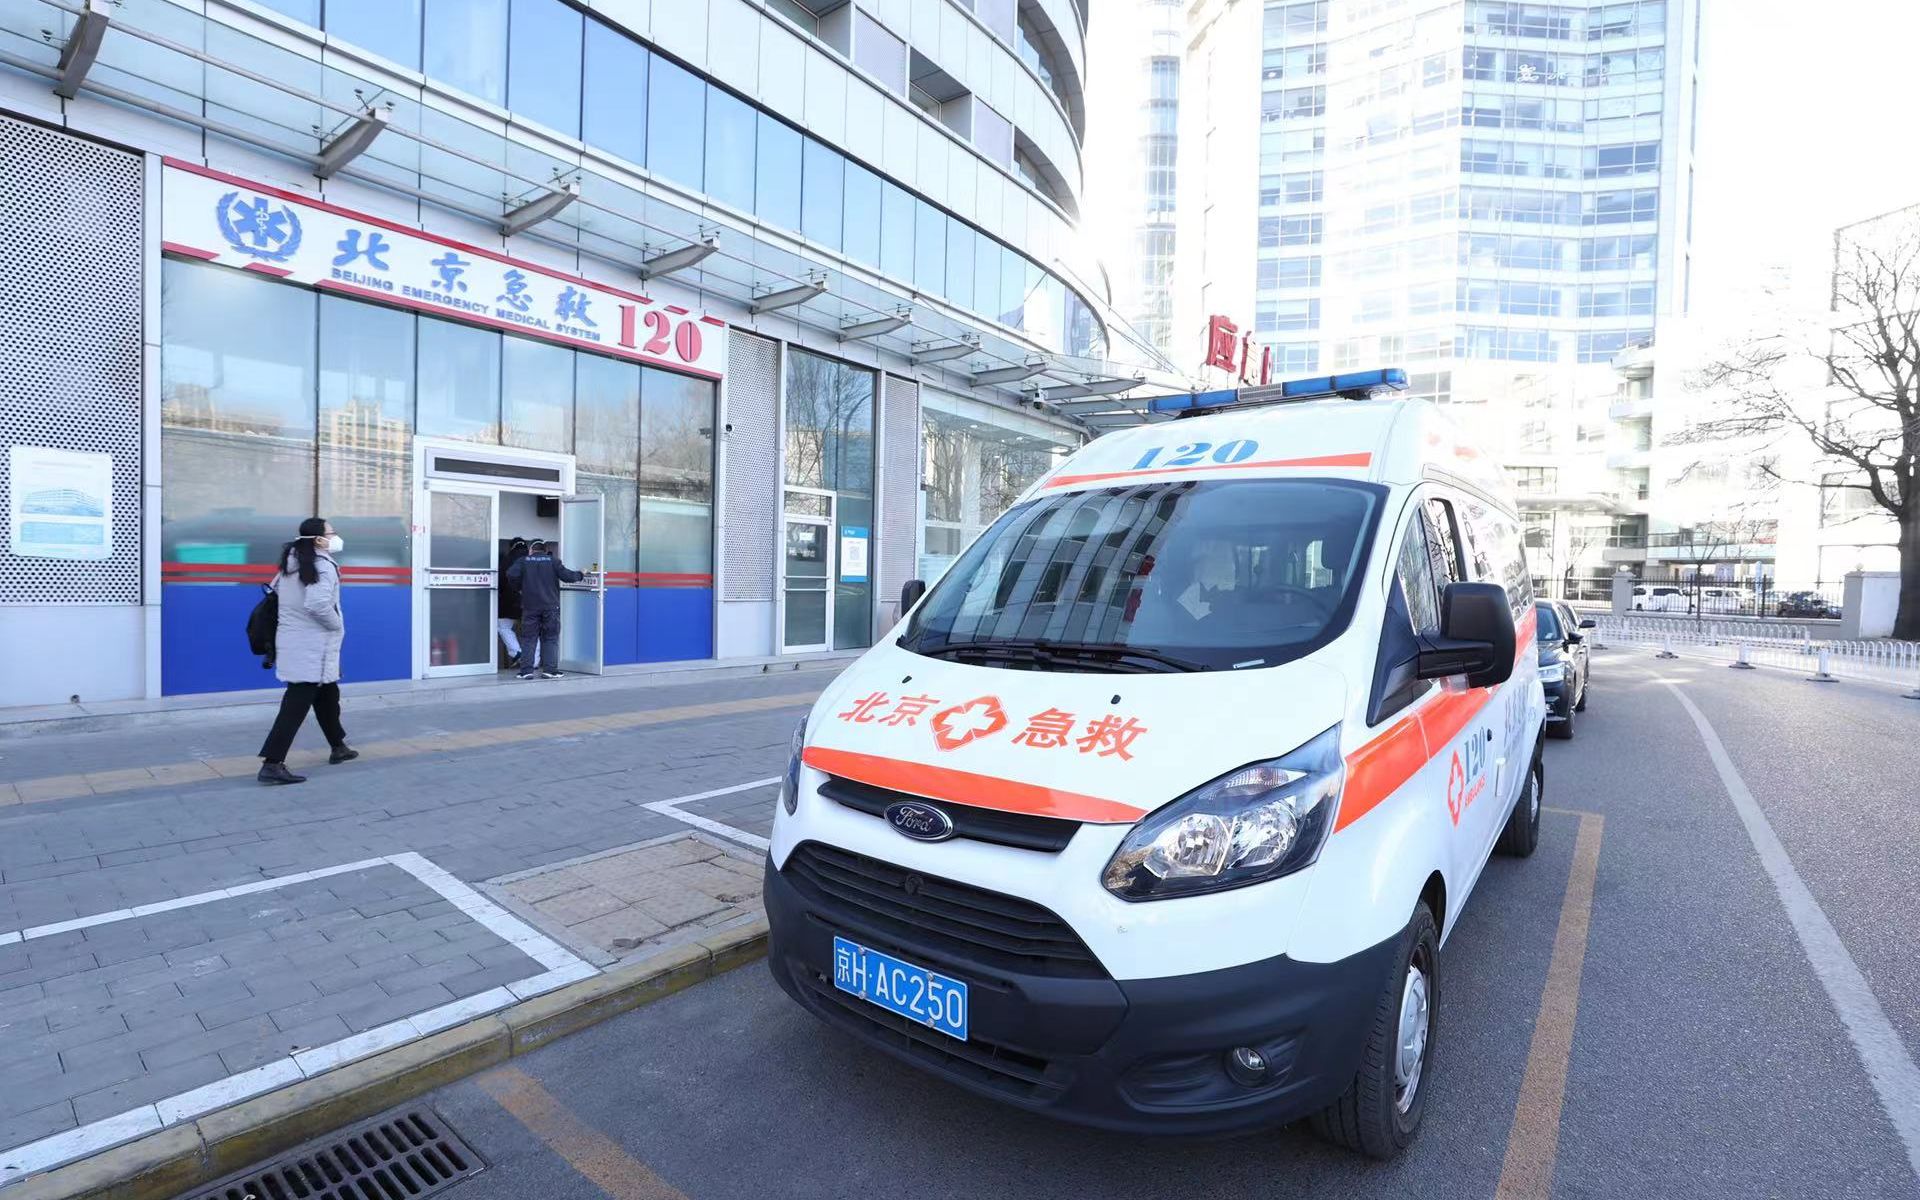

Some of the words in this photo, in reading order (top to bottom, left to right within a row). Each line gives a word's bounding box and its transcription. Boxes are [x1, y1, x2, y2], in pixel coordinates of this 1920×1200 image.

[331, 267, 393, 291] BEIJING
[402, 285, 489, 316] EMERGENCY
[496, 306, 550, 331] MEDICAL
[555, 323, 601, 342] SYSTEM
[332, 229, 597, 327] 北京急救
[617, 303, 703, 363] 120
[1129, 439, 1260, 470] 120
[838, 691, 941, 727] 北京
[1011, 706, 1148, 762] 急救
[1464, 726, 1486, 785] 120
[895, 806, 934, 832] Ford
